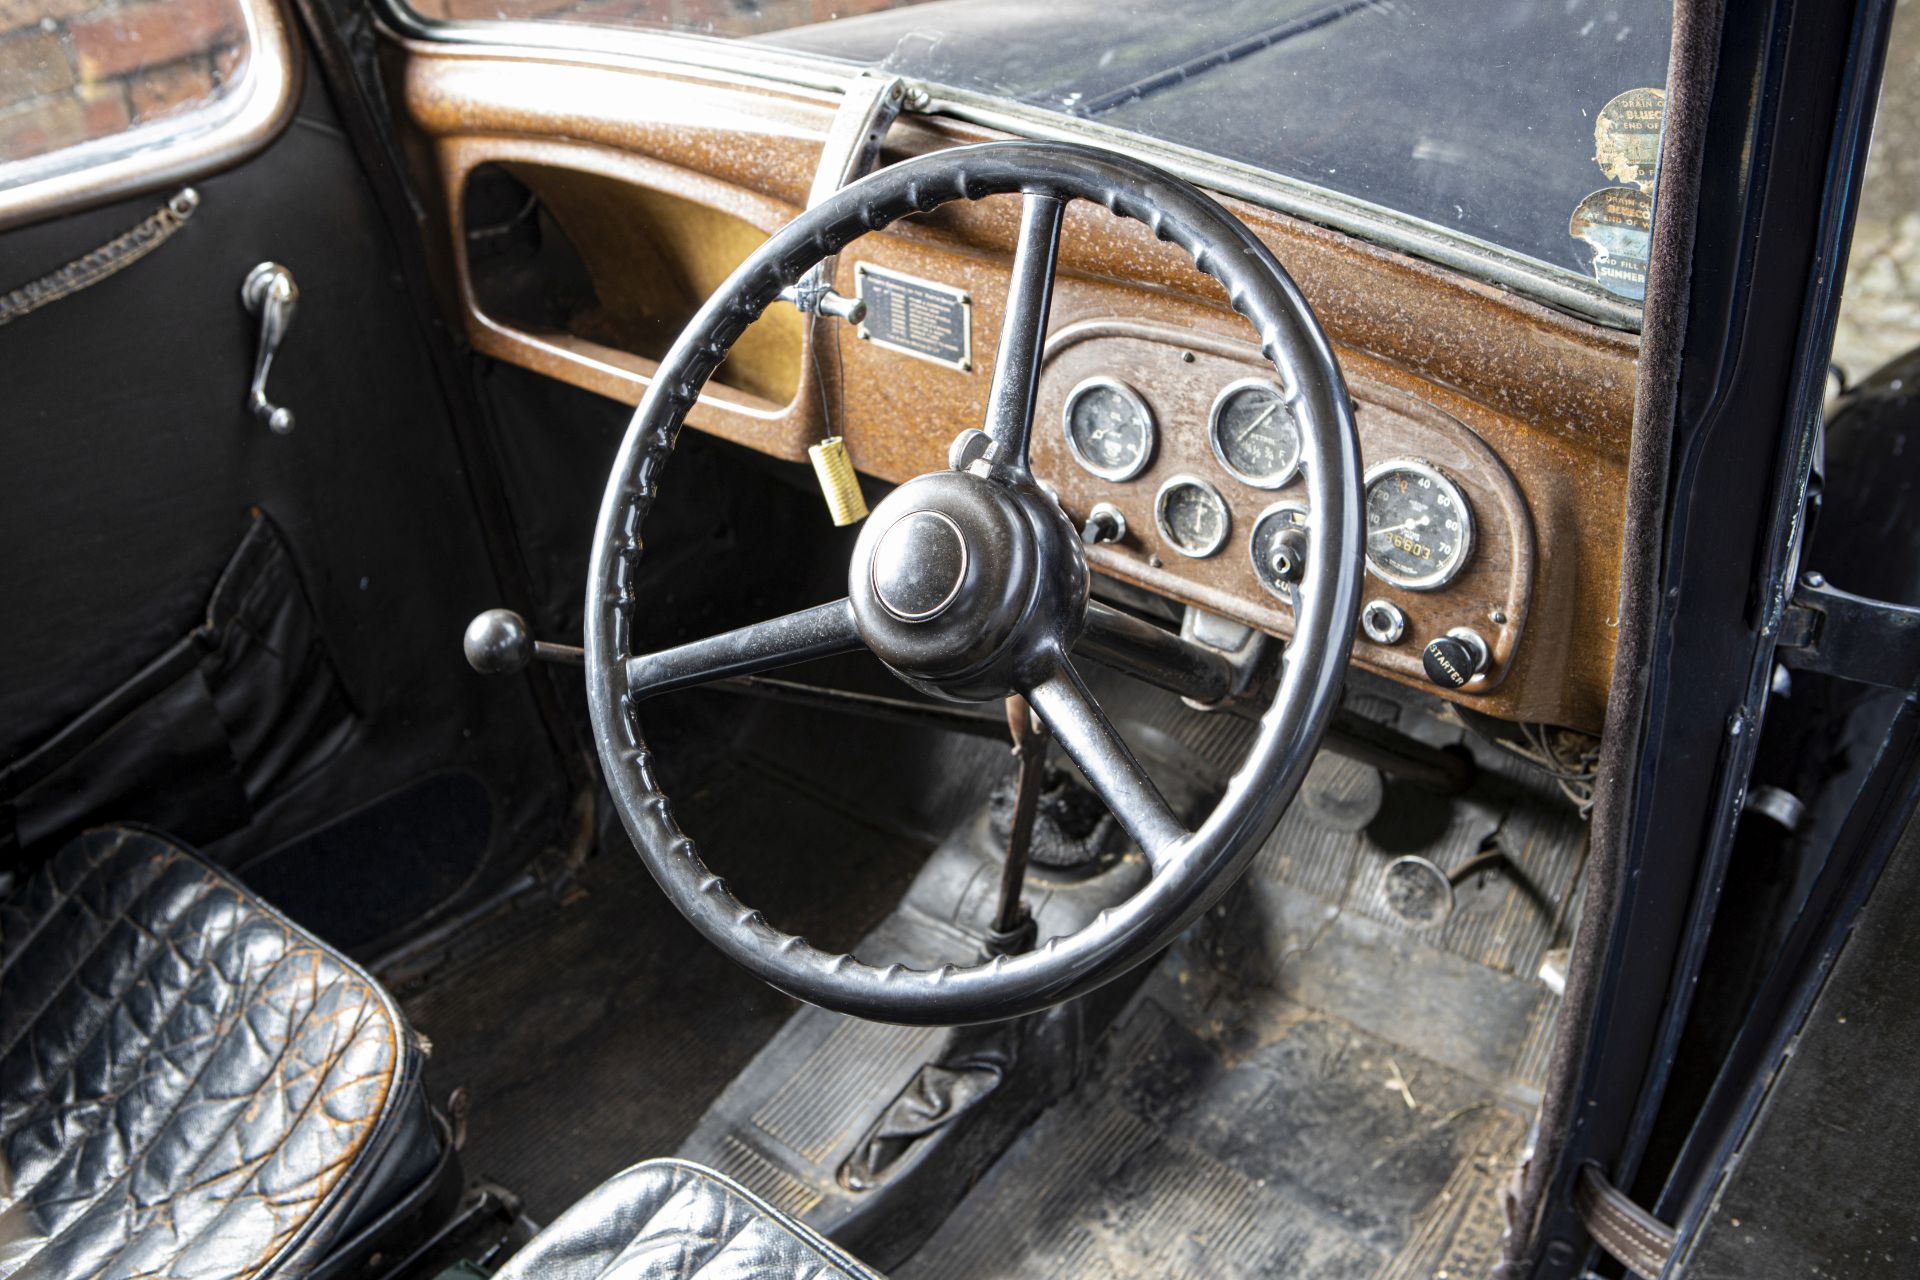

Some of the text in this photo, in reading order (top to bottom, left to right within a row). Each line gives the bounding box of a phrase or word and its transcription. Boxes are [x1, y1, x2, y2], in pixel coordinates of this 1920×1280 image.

[1622, 100, 1652, 108] DRAIN
[1621, 261, 1639, 271] FILL
[1600, 267, 1645, 283] SUMMER
[1417, 477, 1431, 489] 40
[1370, 513, 1380, 524] 10
[1445, 519, 1458, 531] 60
[1438, 541, 1451, 555] 70
[1429, 644, 1464, 686] STARTER
